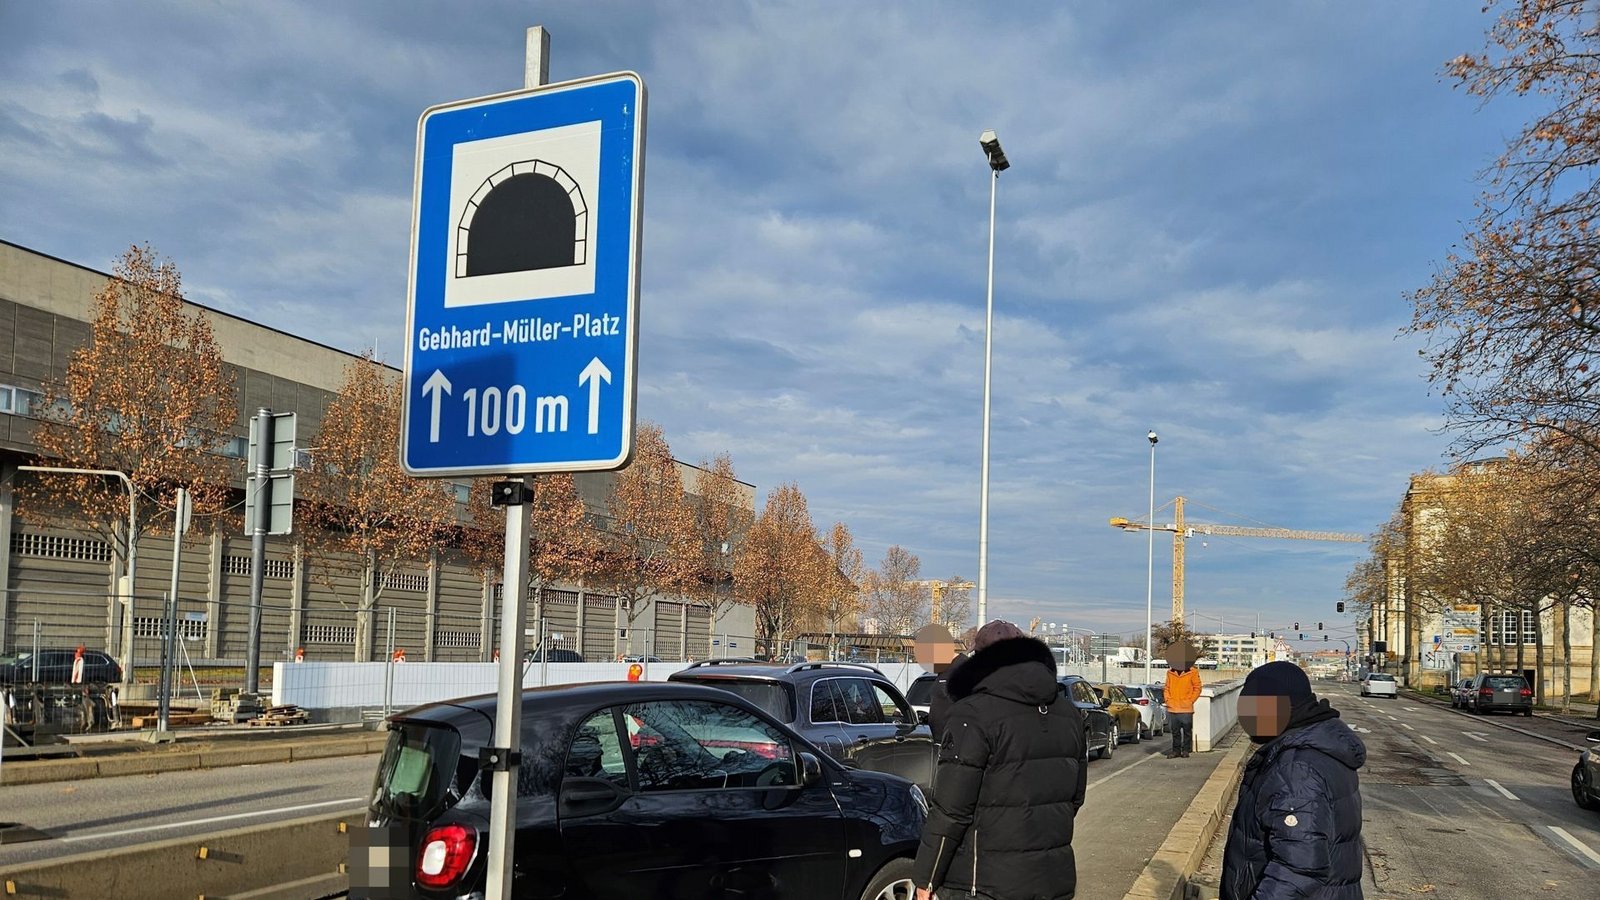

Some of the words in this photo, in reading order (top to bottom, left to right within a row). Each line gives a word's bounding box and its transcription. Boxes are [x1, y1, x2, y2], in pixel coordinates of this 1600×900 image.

[419, 313, 620, 351] Gebhard-Müller-Platz
[463, 384, 526, 436] 100
[535, 394, 569, 433] m
